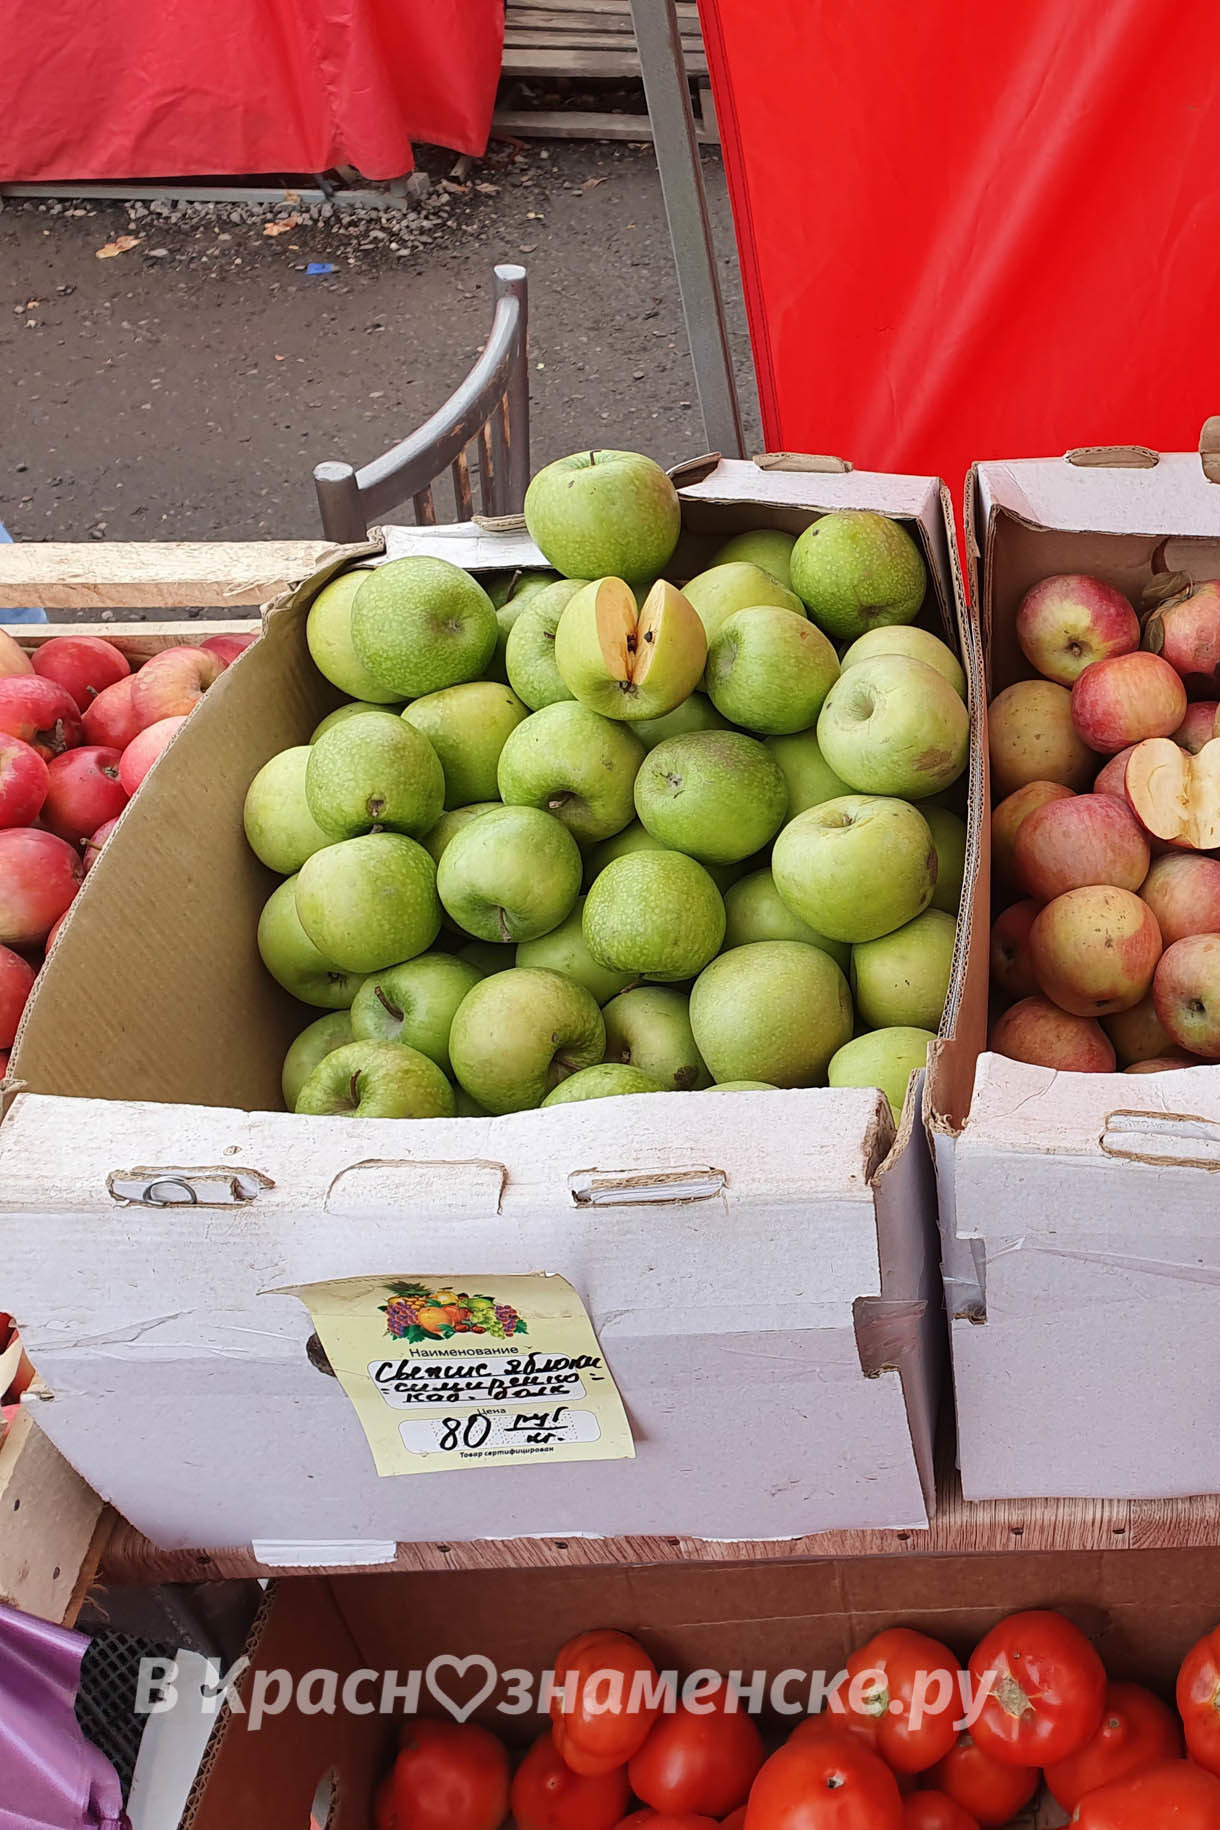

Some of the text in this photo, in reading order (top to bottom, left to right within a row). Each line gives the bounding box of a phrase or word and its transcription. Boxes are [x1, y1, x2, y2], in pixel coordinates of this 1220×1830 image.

[409, 1346, 519, 1358] Наименование
[477, 1407, 507, 1416] Цена
[439, 1413, 492, 1451] 80
[459, 1446, 555, 1459] Товар сертифицирован
